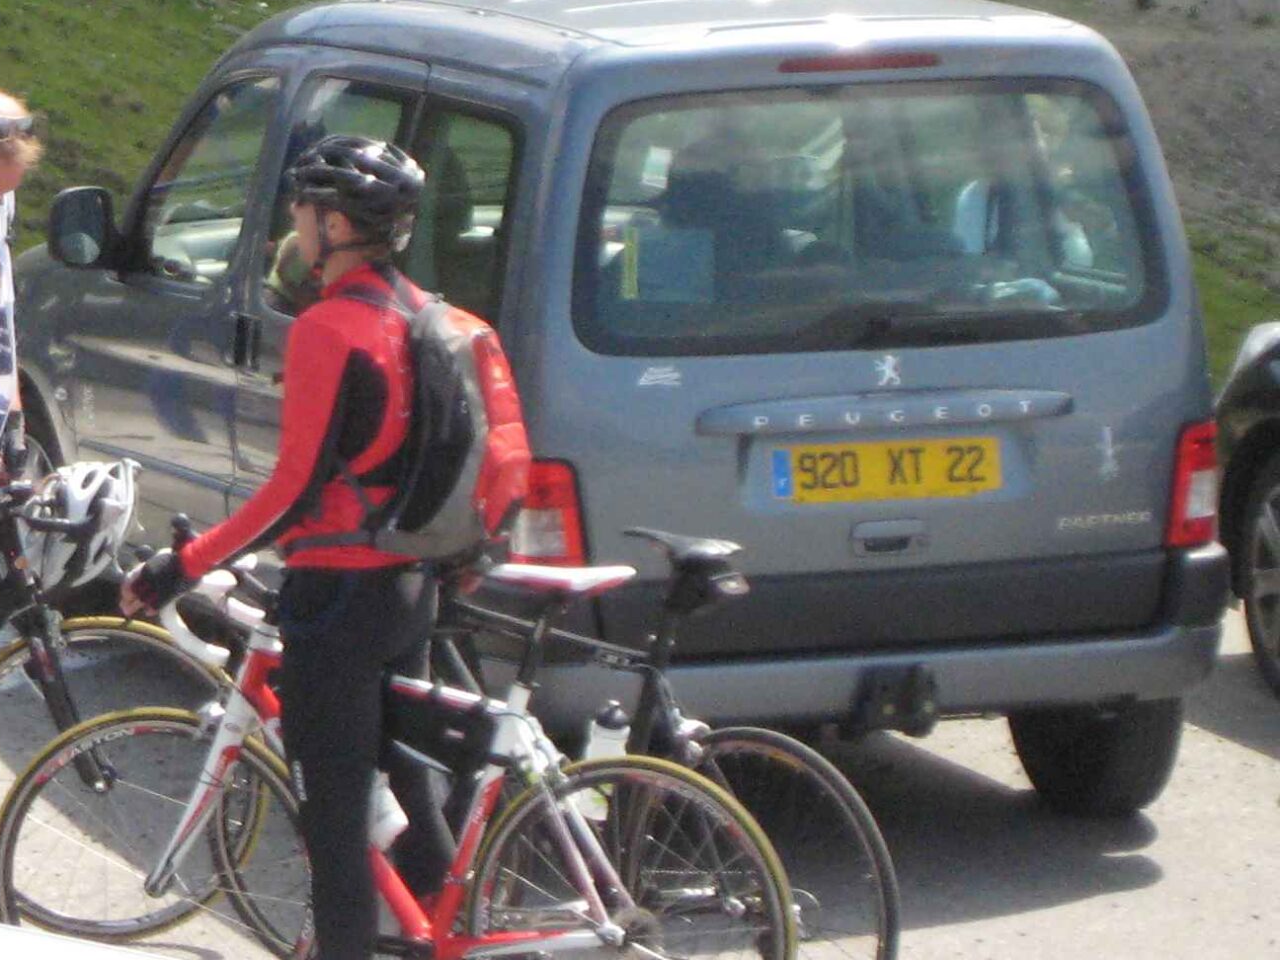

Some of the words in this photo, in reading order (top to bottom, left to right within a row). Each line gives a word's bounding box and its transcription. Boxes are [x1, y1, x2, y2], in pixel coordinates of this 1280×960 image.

[753, 399, 1033, 428] PEUGEOT
[798, 450, 860, 490] 920
[887, 447, 926, 486] XT
[946, 445, 987, 484] 22
